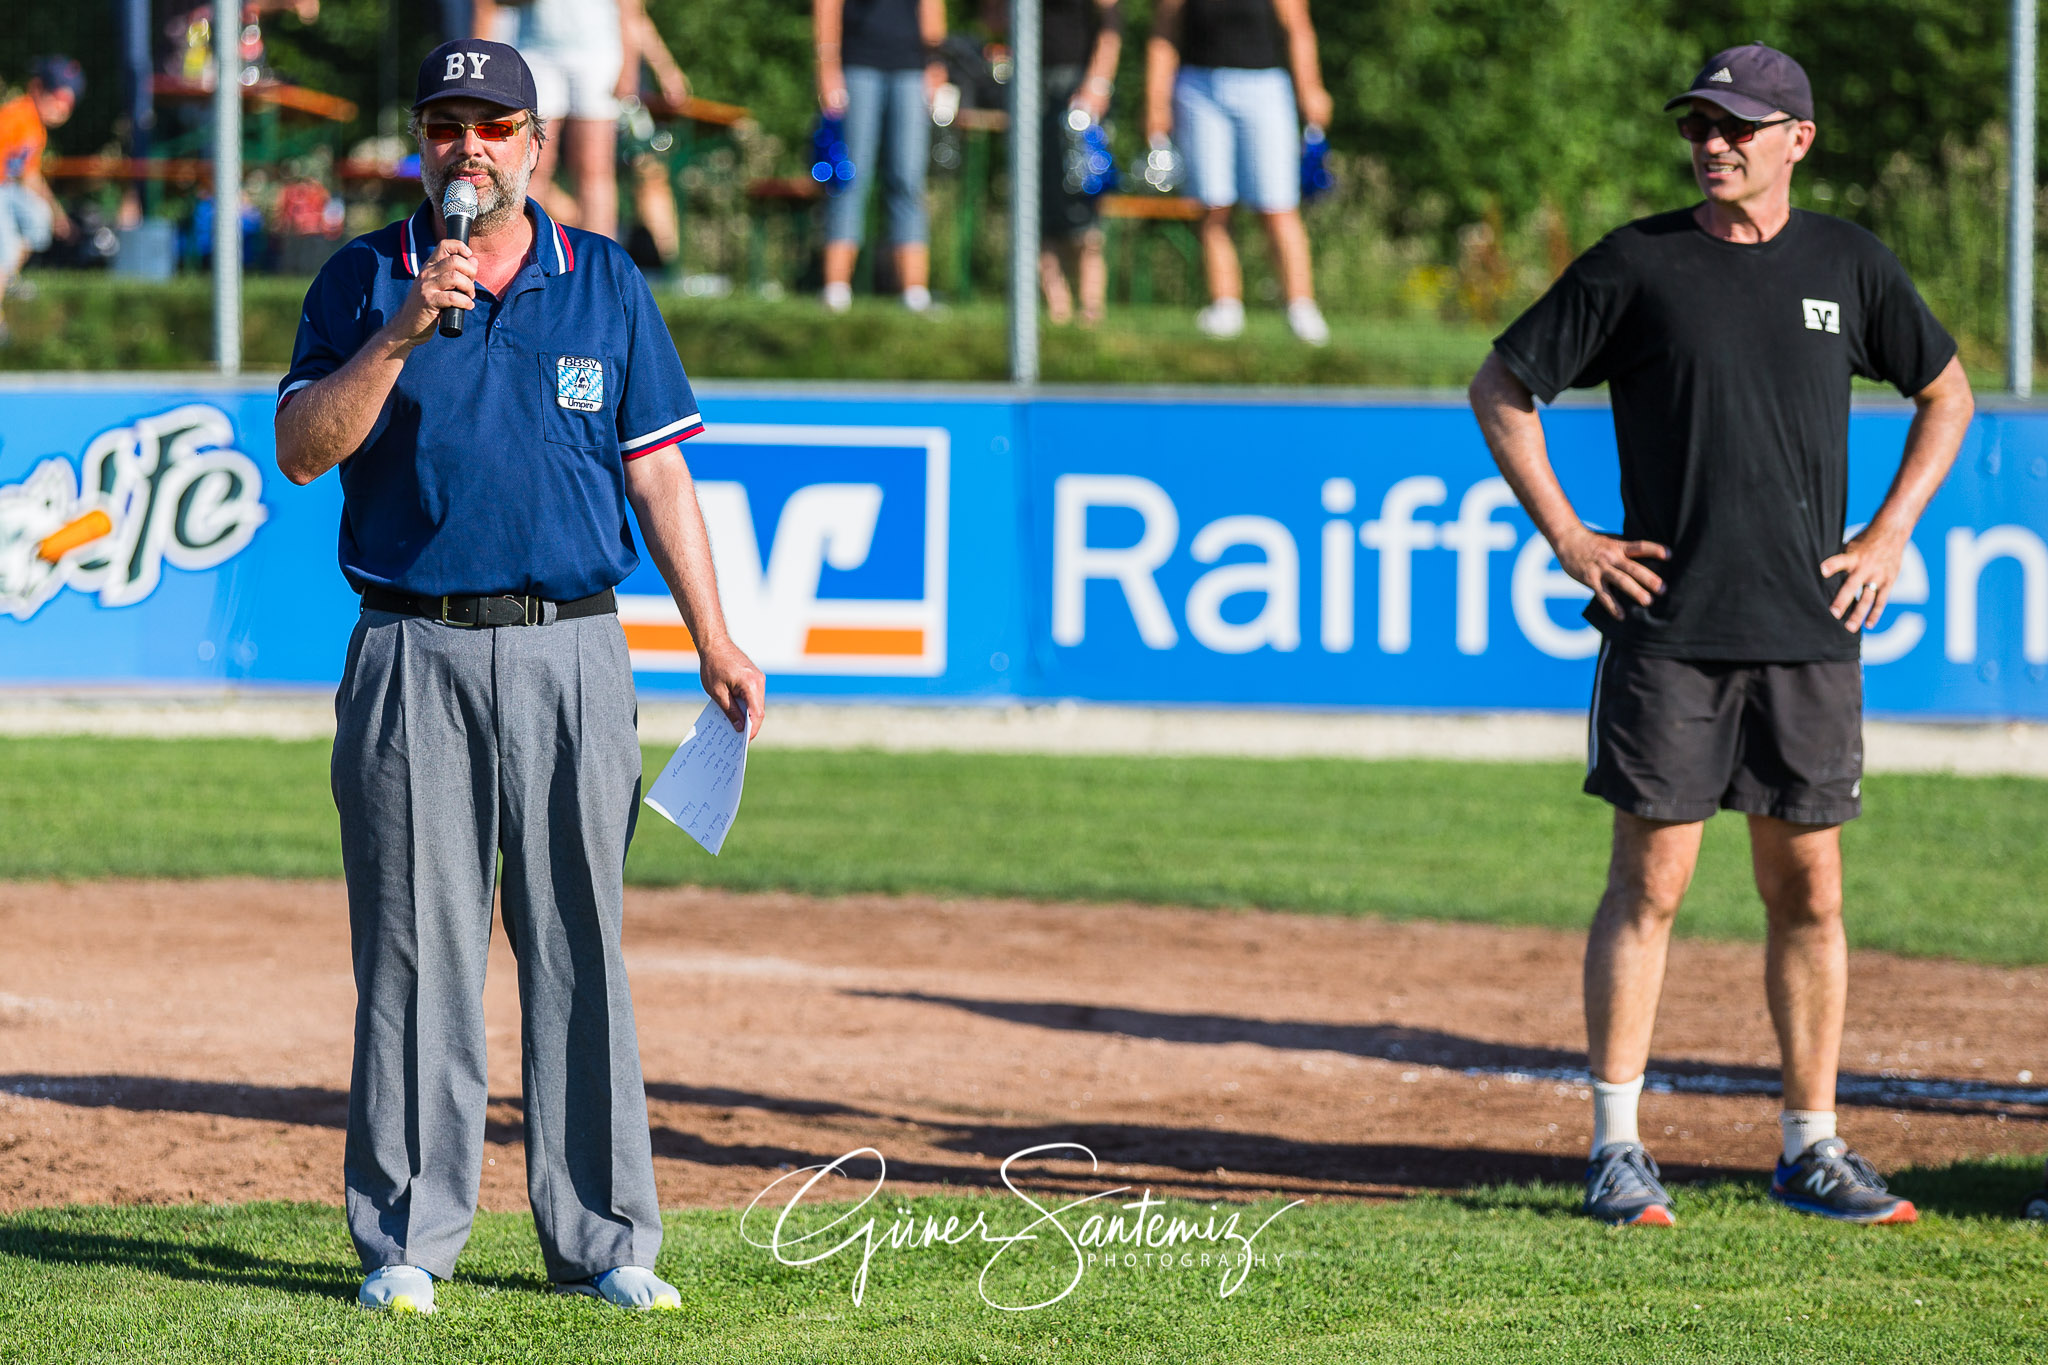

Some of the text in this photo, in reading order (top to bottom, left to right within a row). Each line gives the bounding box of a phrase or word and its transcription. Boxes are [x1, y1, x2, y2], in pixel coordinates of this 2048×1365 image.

[443, 52, 491, 81] BY
[564, 357, 598, 369] BBSV
[567, 398, 594, 410] Umpire
[1051, 472, 2048, 668] Raiffeen
